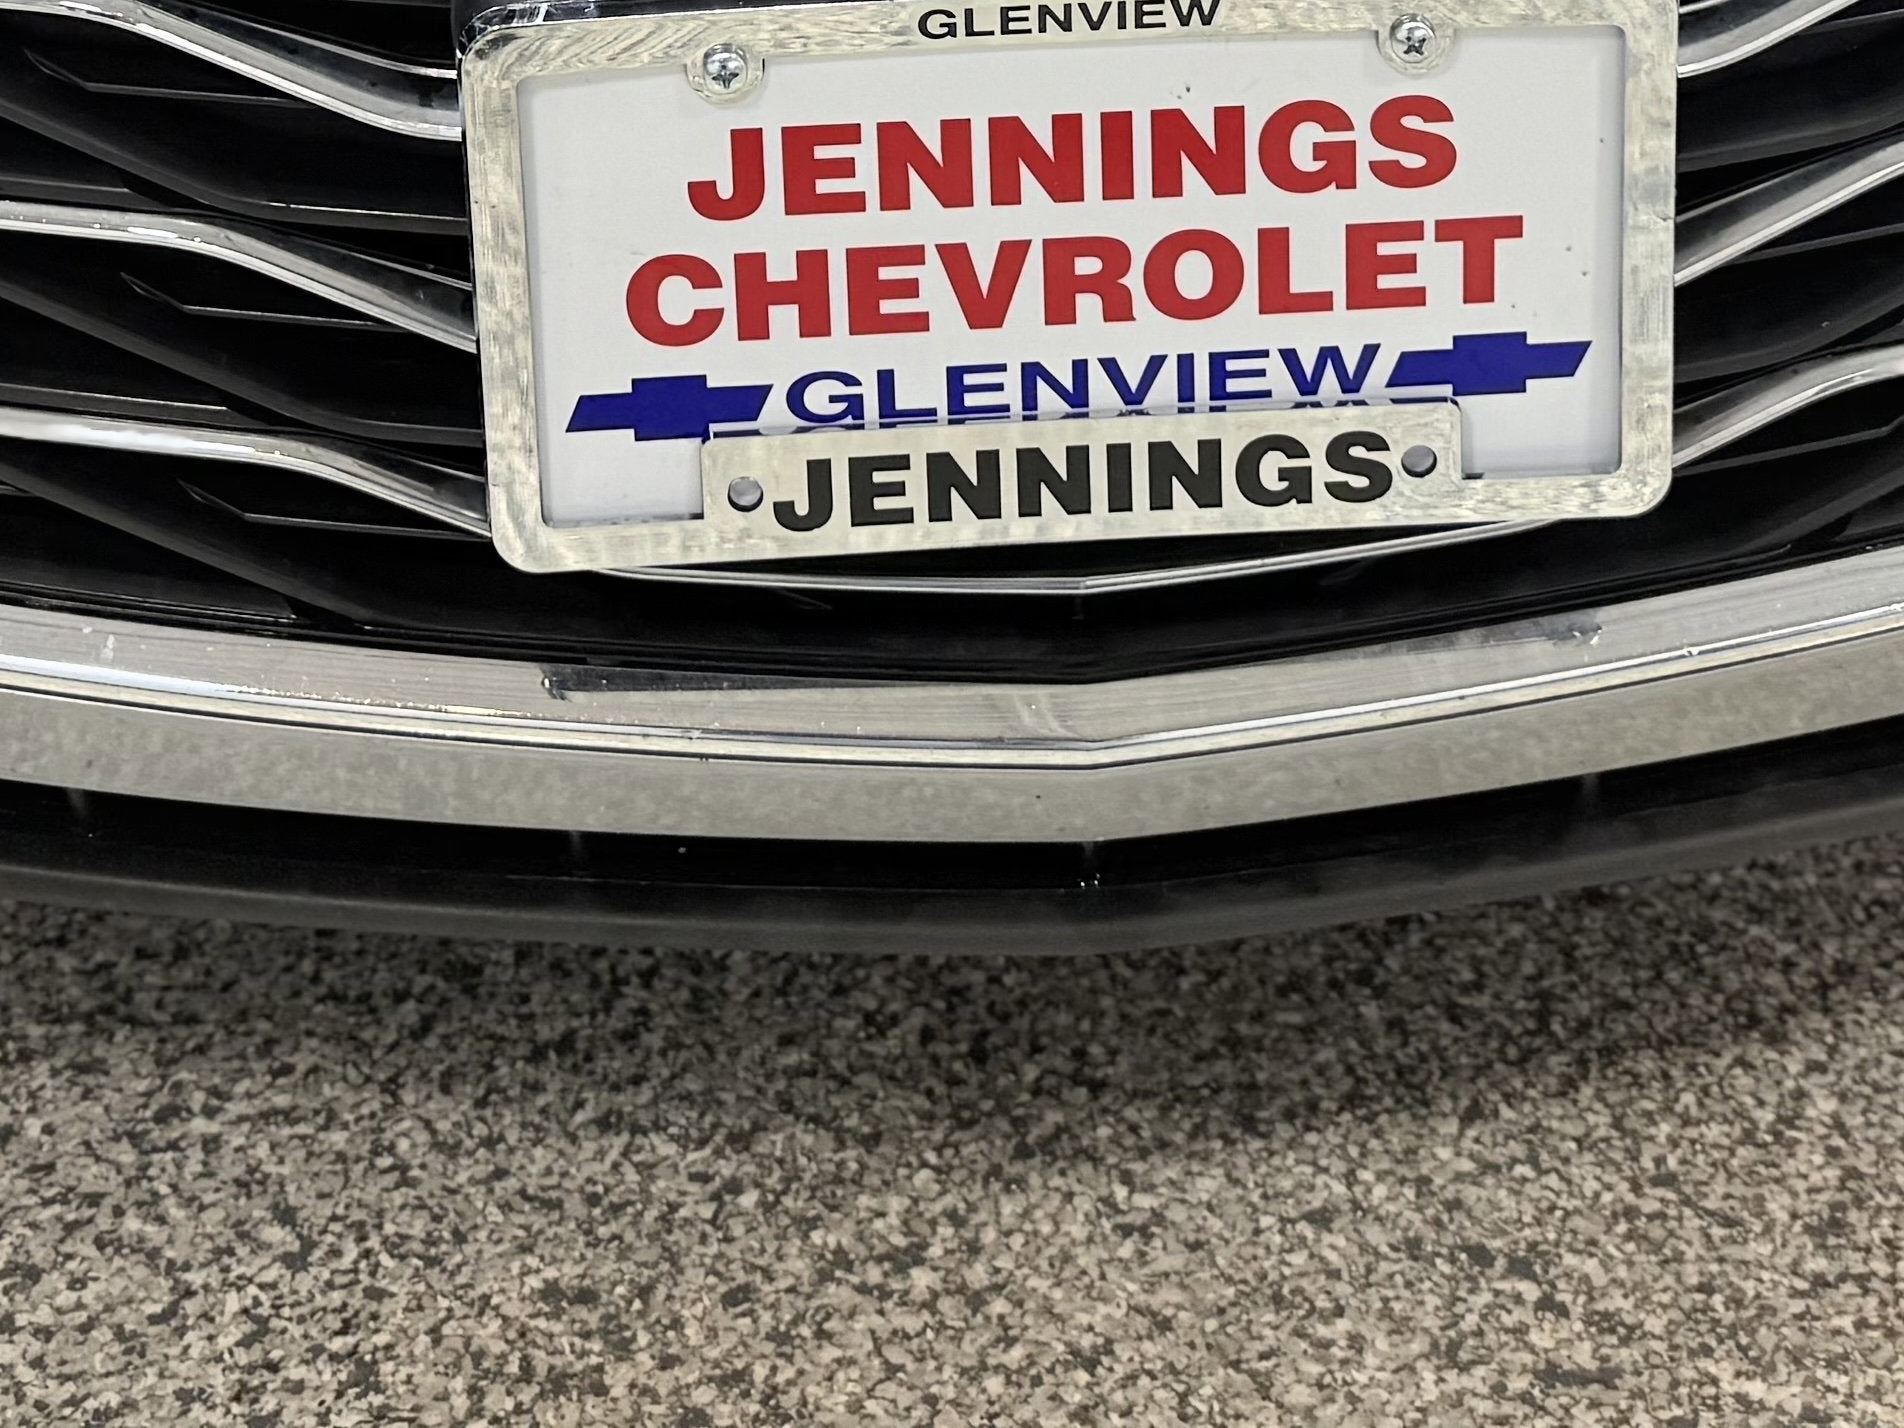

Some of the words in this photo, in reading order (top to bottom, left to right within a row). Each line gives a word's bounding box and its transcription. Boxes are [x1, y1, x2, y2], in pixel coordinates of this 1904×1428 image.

[687, 95, 1458, 222] JENNINGS
[626, 215, 1525, 348] CHEVROLET
[785, 343, 1381, 427] GLENVIEW
[772, 431, 1394, 532] JENNINGS
